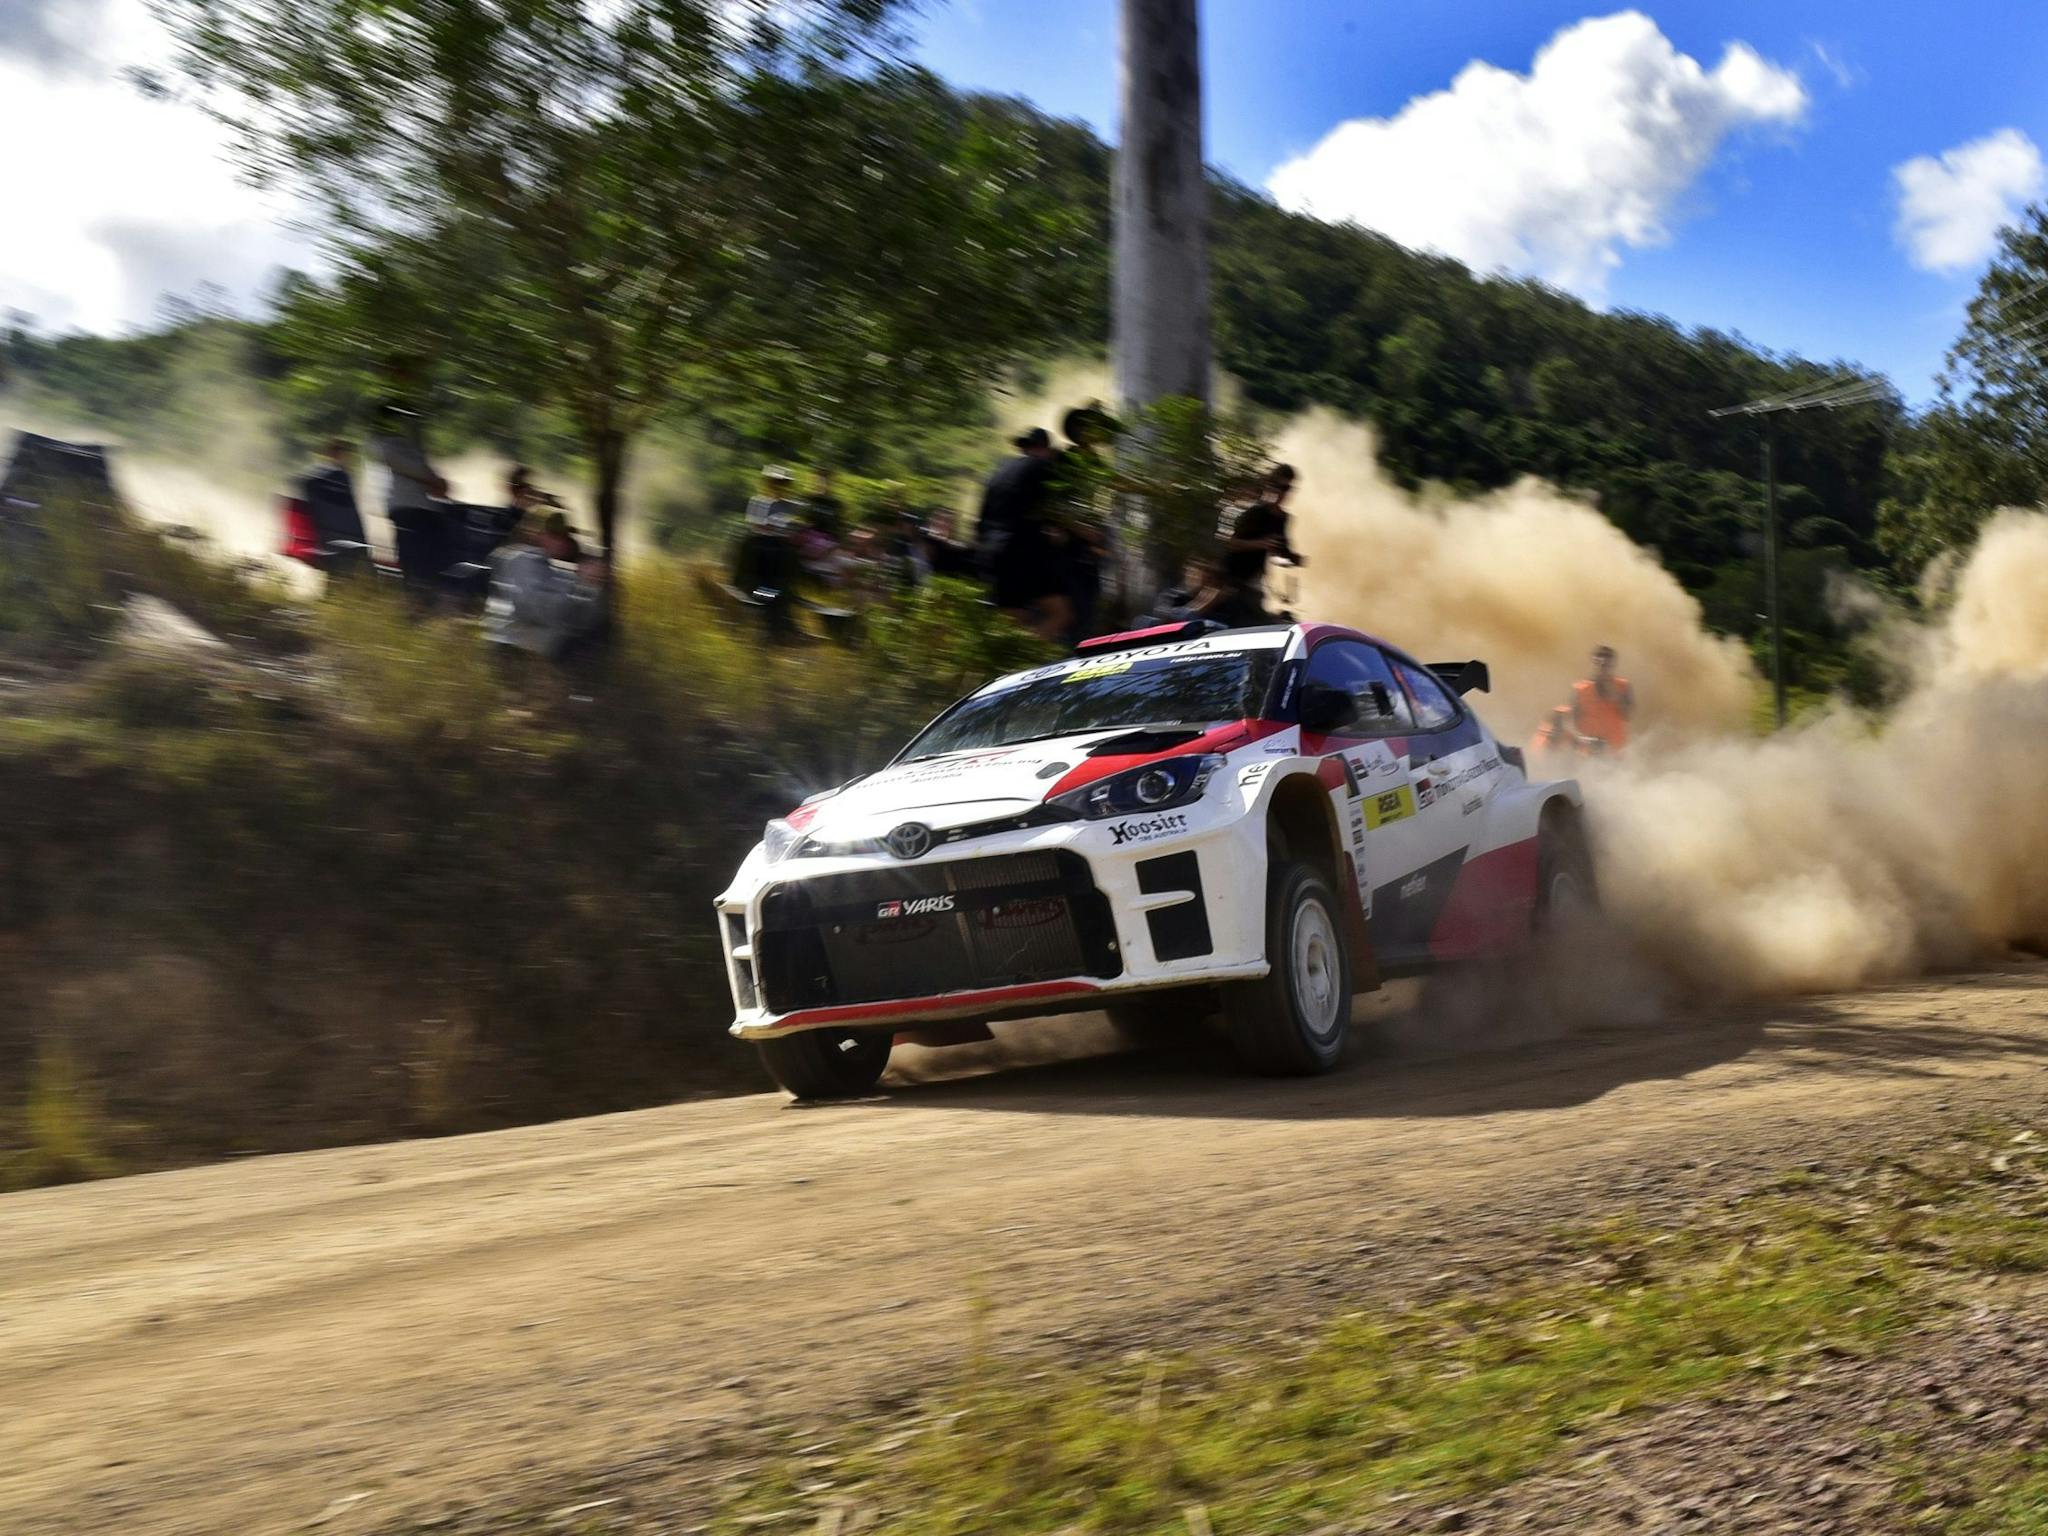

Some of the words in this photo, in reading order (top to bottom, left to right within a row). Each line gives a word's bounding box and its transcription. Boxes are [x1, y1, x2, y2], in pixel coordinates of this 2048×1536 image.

[1077, 641, 1211, 667] TOYOTA
[1108, 814, 1187, 845] Hoosier
[878, 906, 901, 918] GR
[902, 894, 955, 915] YARIS
